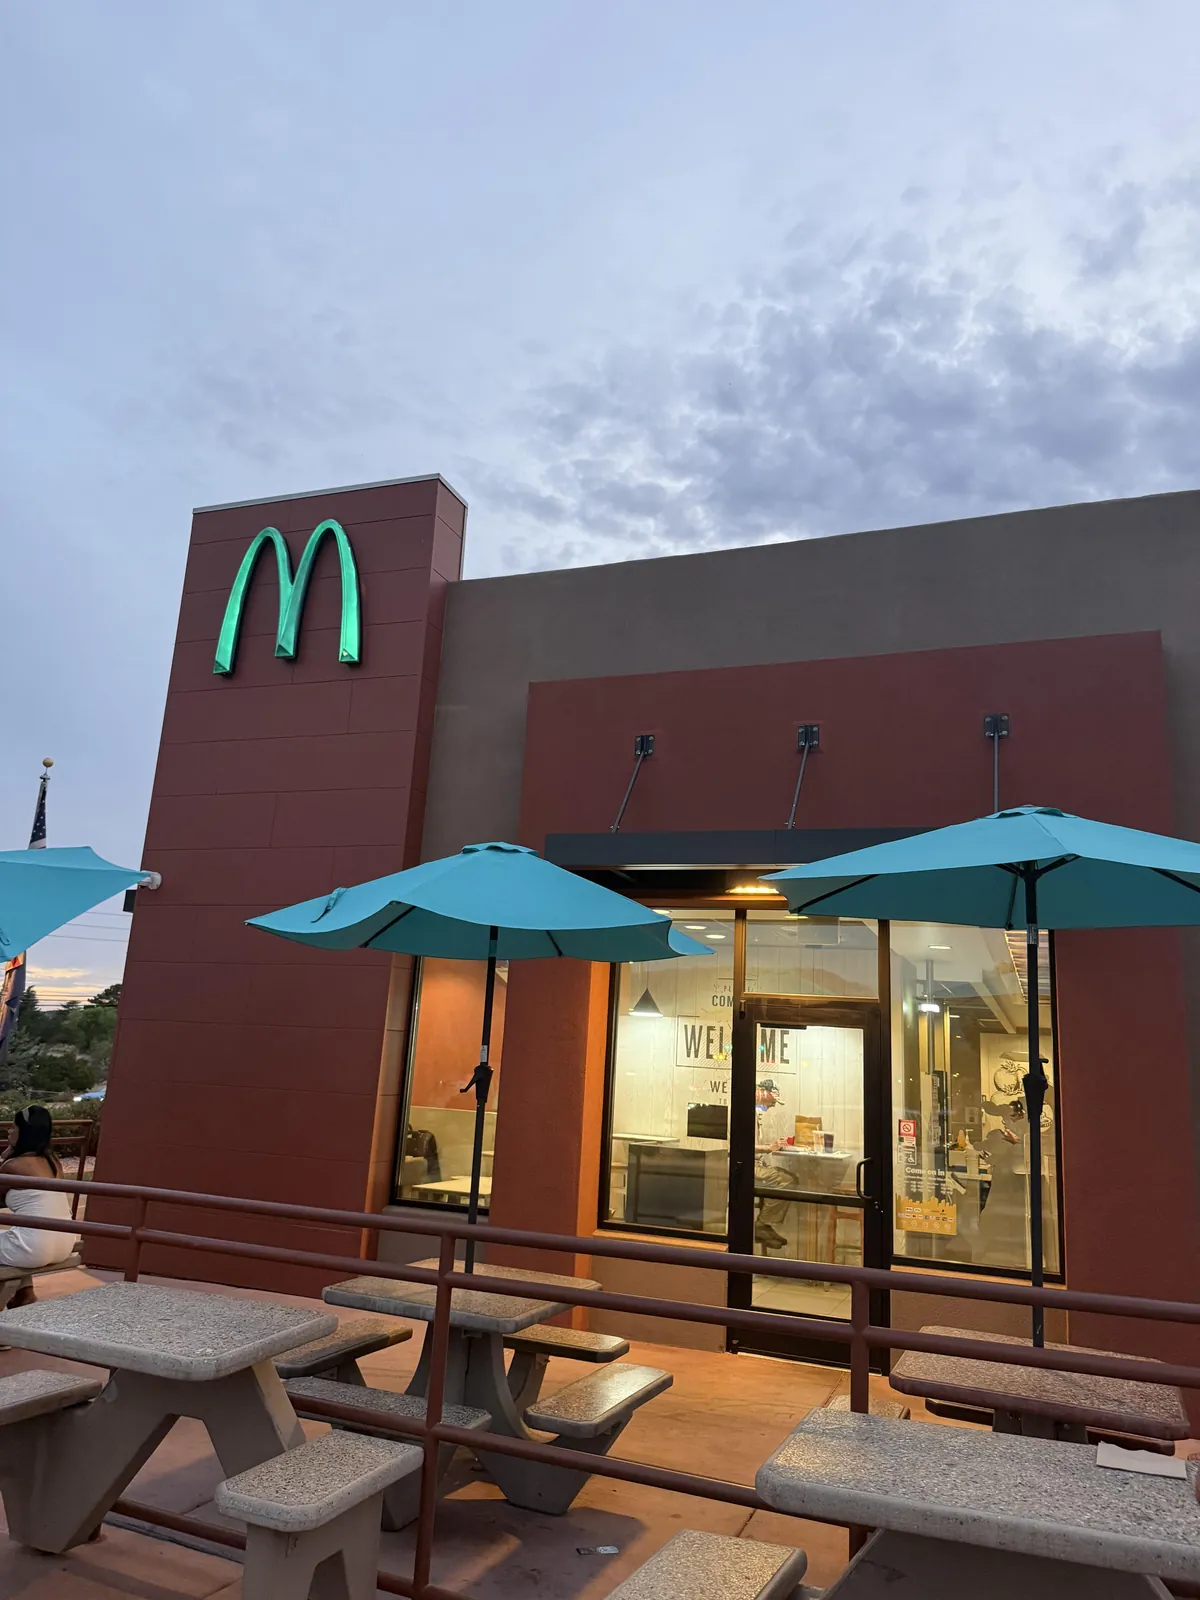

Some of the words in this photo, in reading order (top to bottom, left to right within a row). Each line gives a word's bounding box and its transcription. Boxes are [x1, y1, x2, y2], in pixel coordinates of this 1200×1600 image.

[213, 518, 361, 674] M
[712, 995, 734, 1007] COM
[684, 1024, 790, 1065] WELME
